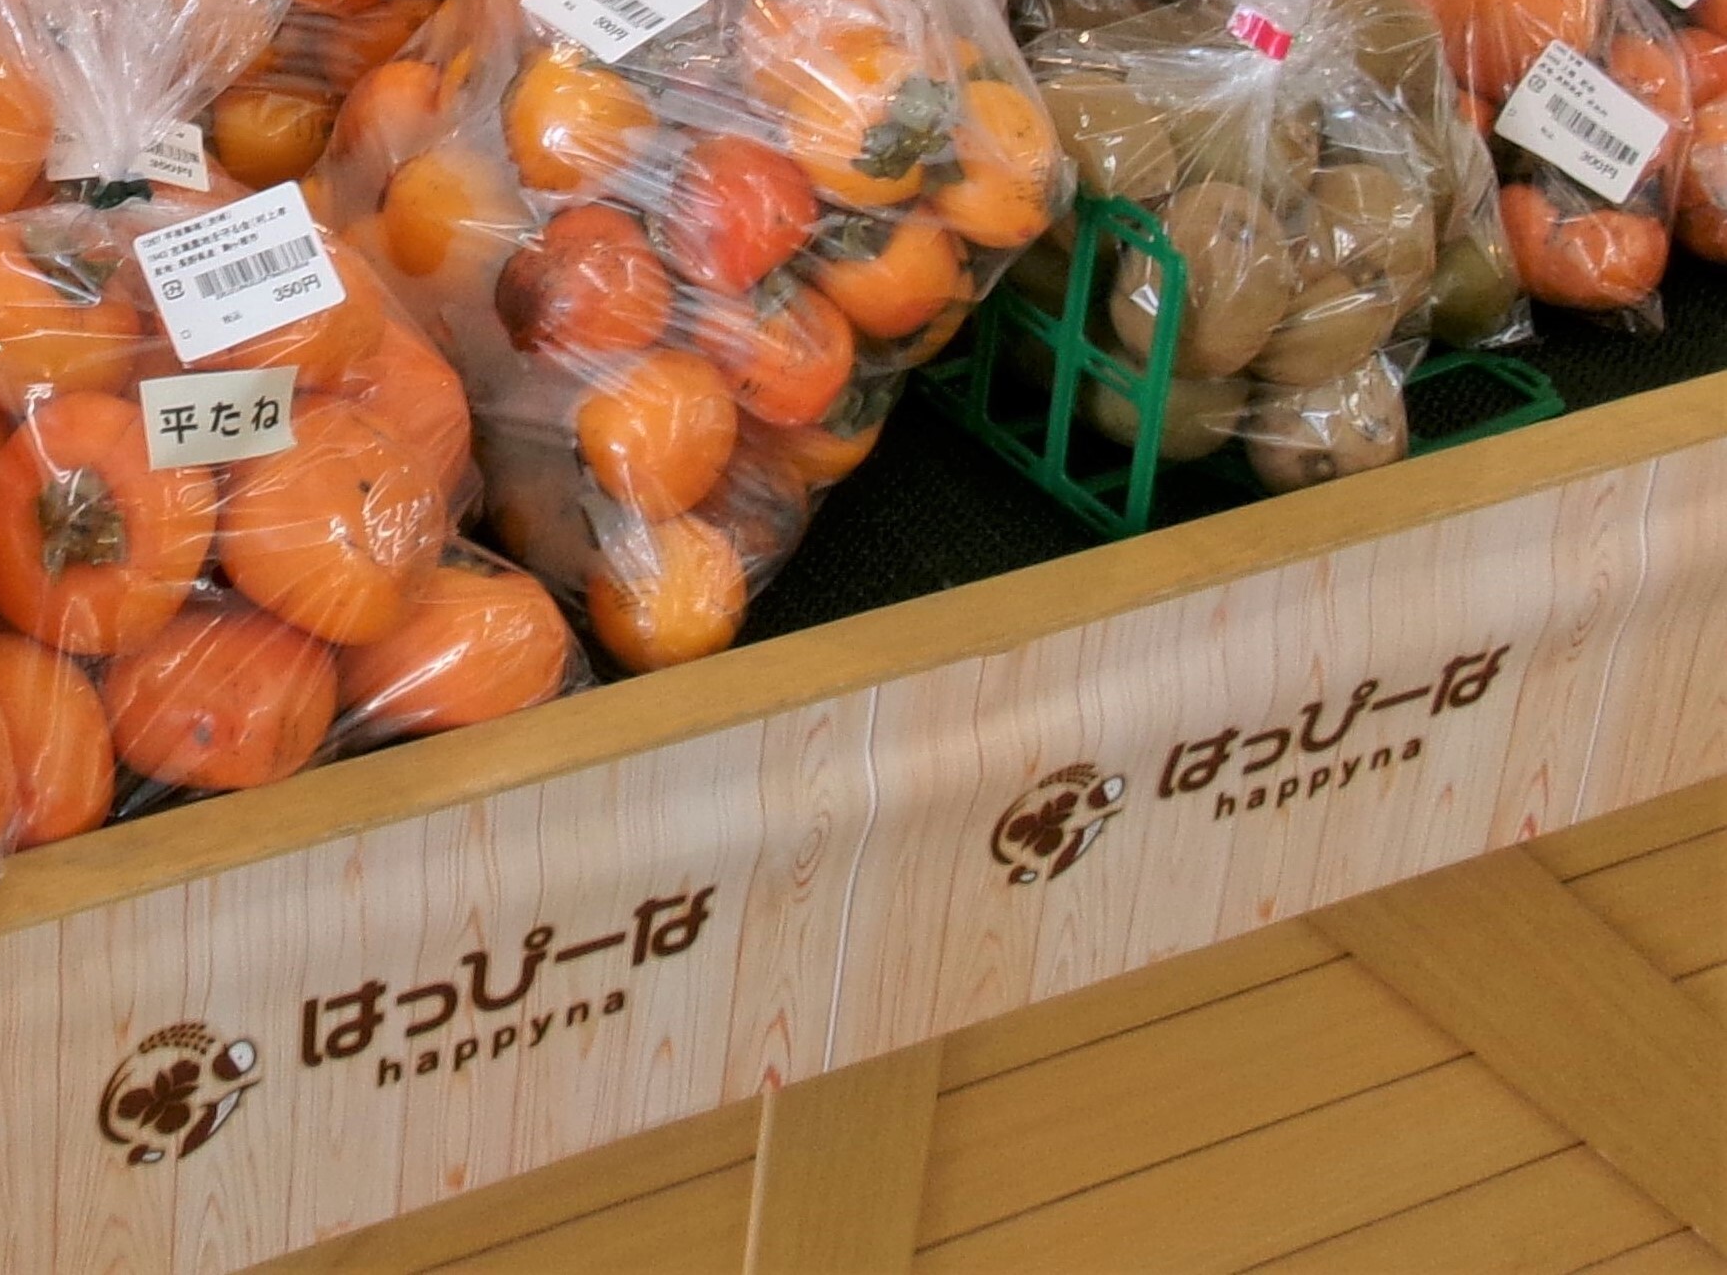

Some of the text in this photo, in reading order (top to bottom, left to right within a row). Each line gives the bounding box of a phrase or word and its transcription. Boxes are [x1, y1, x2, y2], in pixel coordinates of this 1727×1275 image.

[273, 273, 321, 302] 350円
[160, 395, 280, 444] 平たね
[1157, 643, 1511, 800] はっぴーな
[1215, 736, 1423, 821] happyna
[301, 886, 716, 1068] はっぴーな
[377, 988, 626, 1088] happyna
